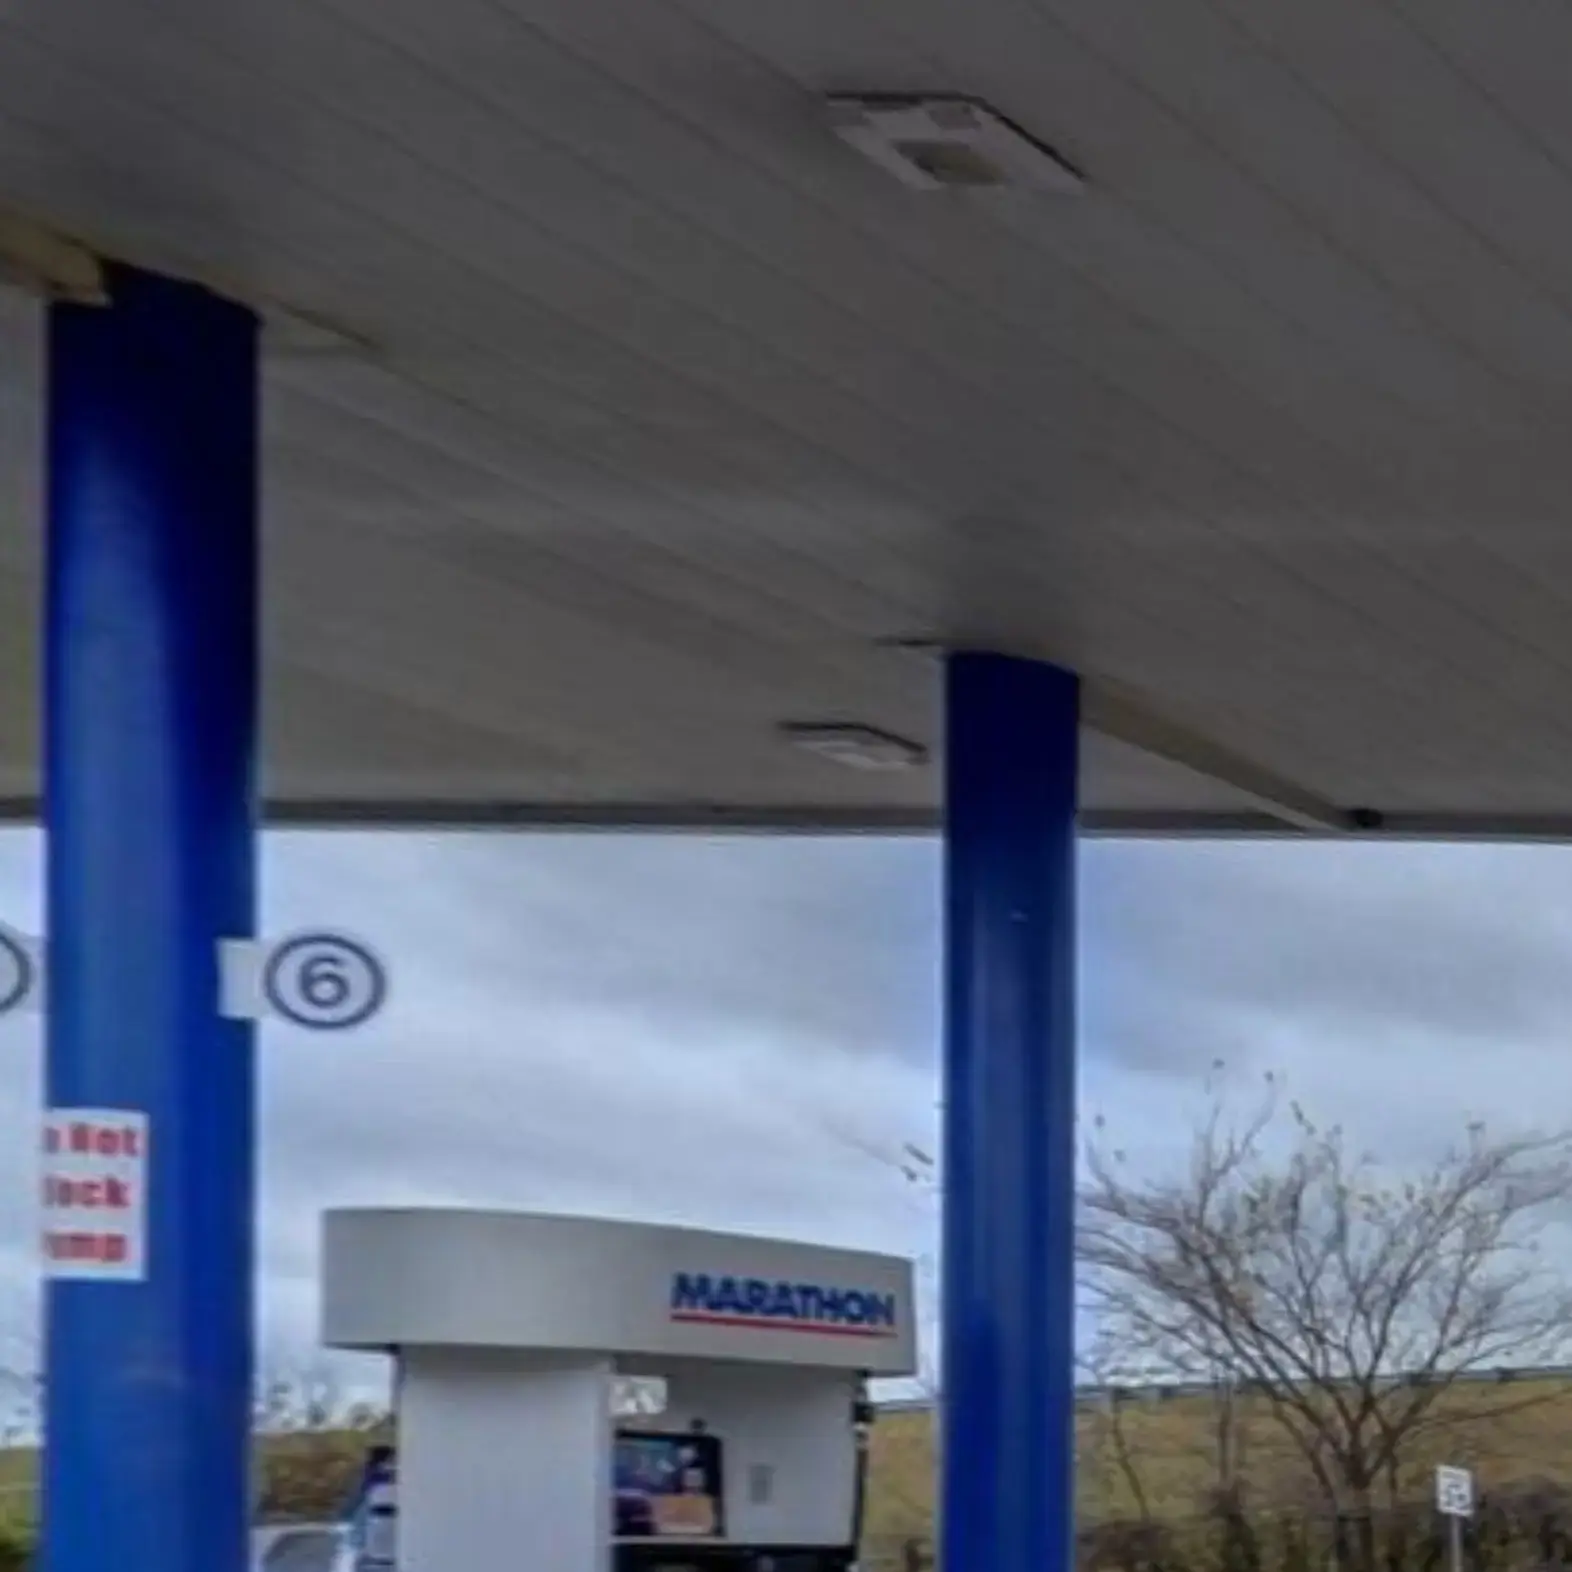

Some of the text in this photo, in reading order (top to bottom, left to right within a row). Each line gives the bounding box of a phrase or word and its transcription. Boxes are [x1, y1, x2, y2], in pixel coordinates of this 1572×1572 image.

[300, 955, 349, 1009] 6
[45, 1176, 129, 1208] lock
[44, 1232, 126, 1263] ump
[671, 1271, 896, 1326] MARATHON
